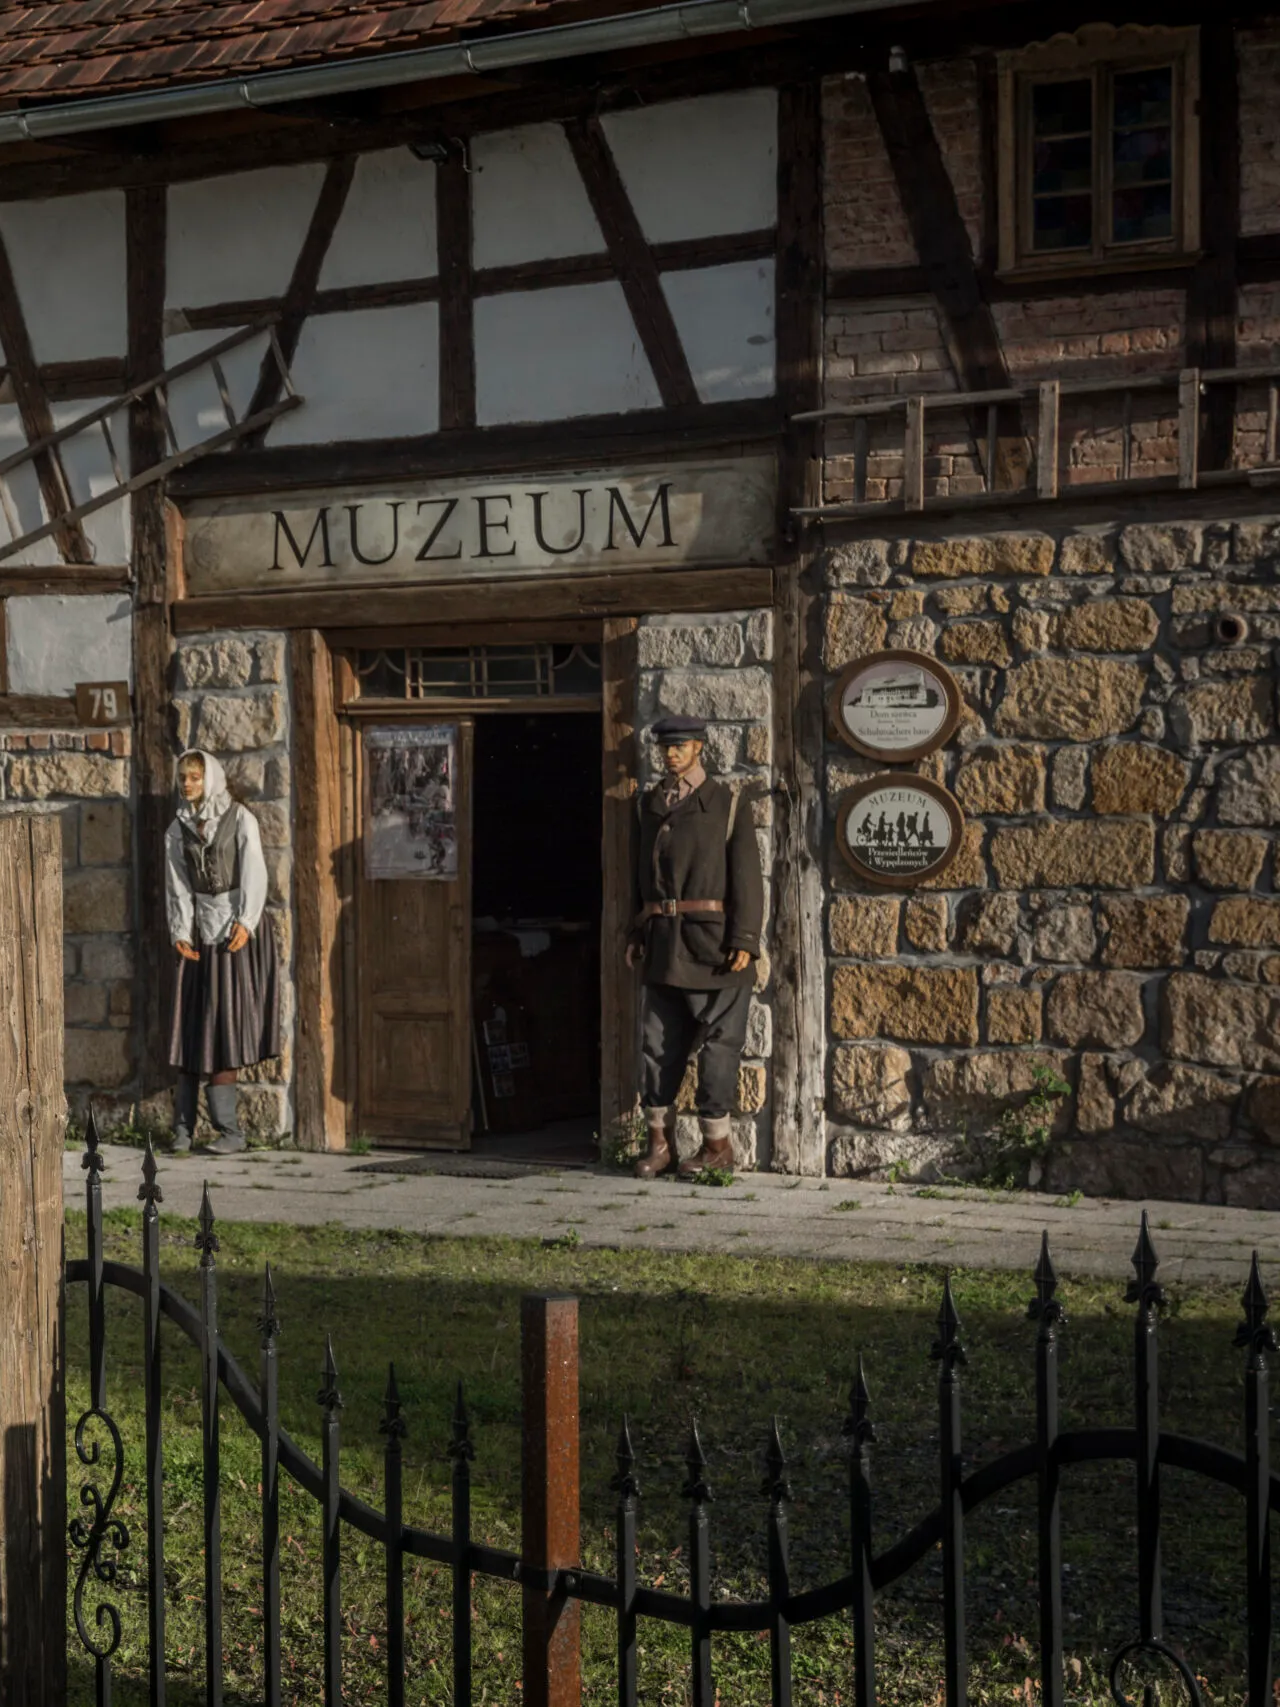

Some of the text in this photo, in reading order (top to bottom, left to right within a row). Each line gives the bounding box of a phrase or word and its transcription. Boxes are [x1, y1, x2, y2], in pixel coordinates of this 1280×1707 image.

[267, 482, 679, 571] MUZEUM
[88, 687, 118, 720] 79
[868, 791, 927, 808] MUZEUM
